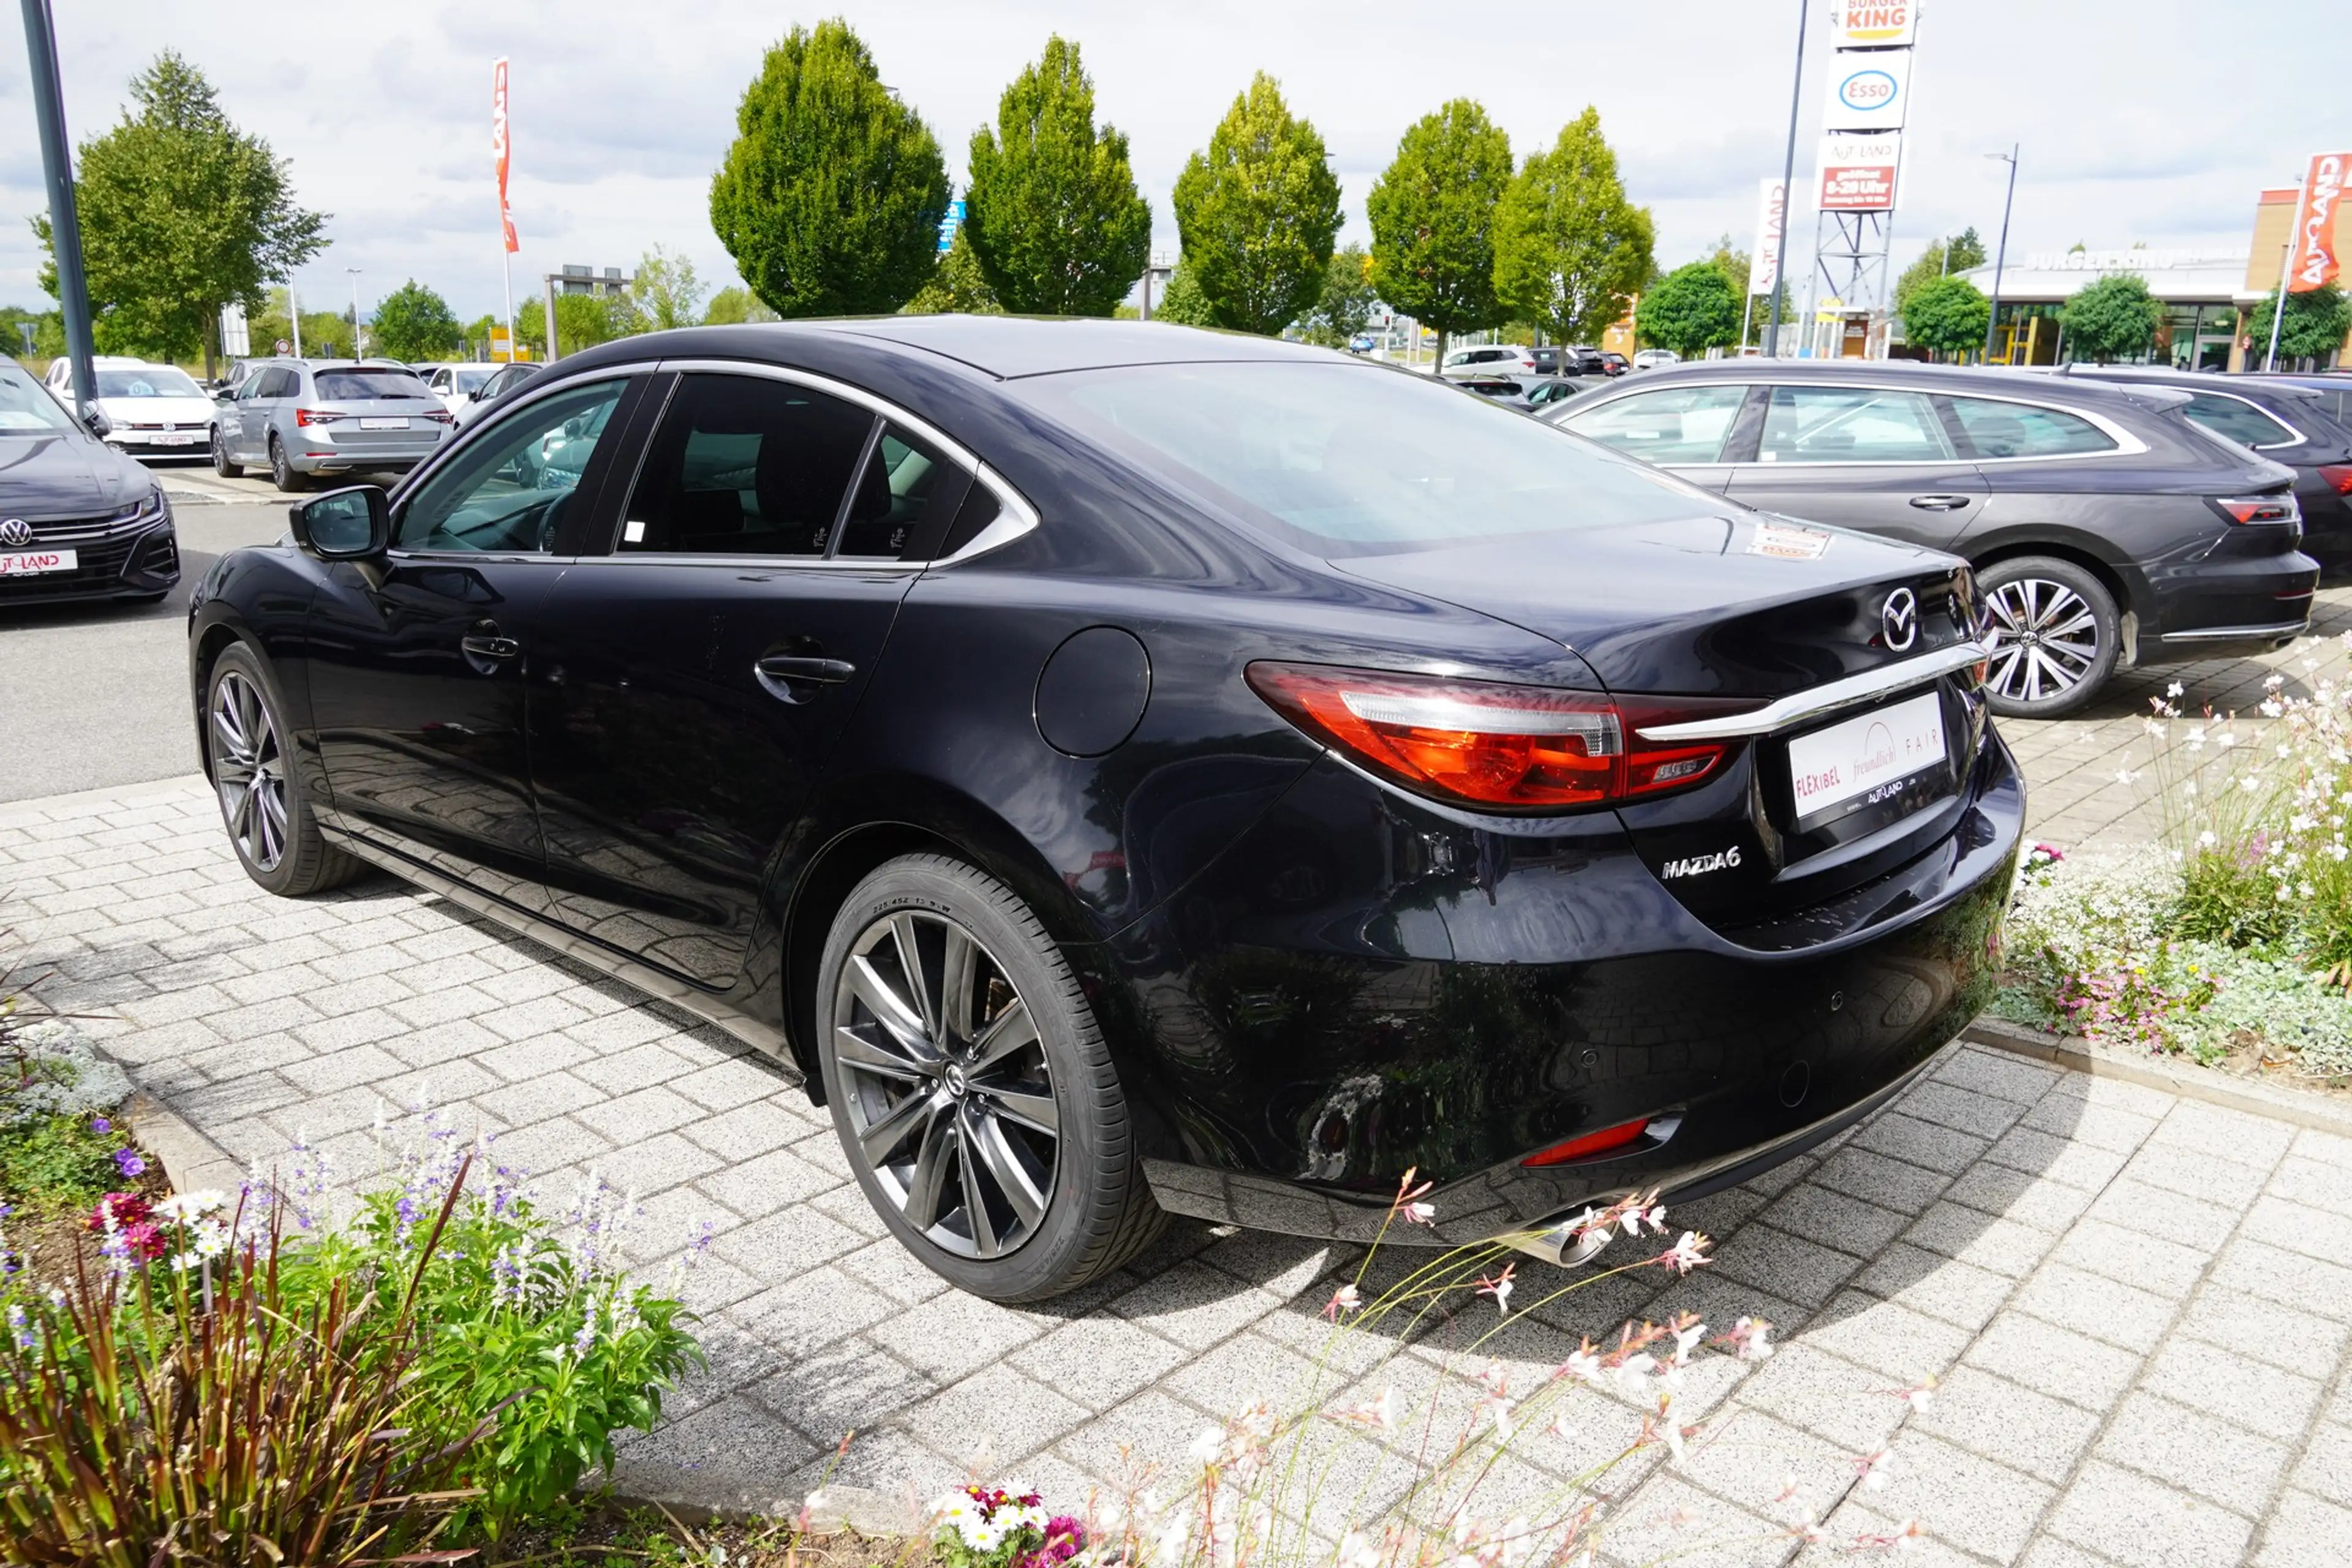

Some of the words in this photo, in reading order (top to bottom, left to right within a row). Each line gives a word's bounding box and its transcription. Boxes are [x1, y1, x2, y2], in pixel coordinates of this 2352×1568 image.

[1846, 8, 1906, 28] KING
[1831, 145, 1892, 160] AUTLAND
[1860, 179, 1890, 194] Uhr
[1796, 765, 1841, 799] FLEXIBEL
[1905, 728, 1939, 756] FAIR
[1868, 781, 1903, 804] AUTOLAND
[1661, 845, 1741, 880] MAZDA6
